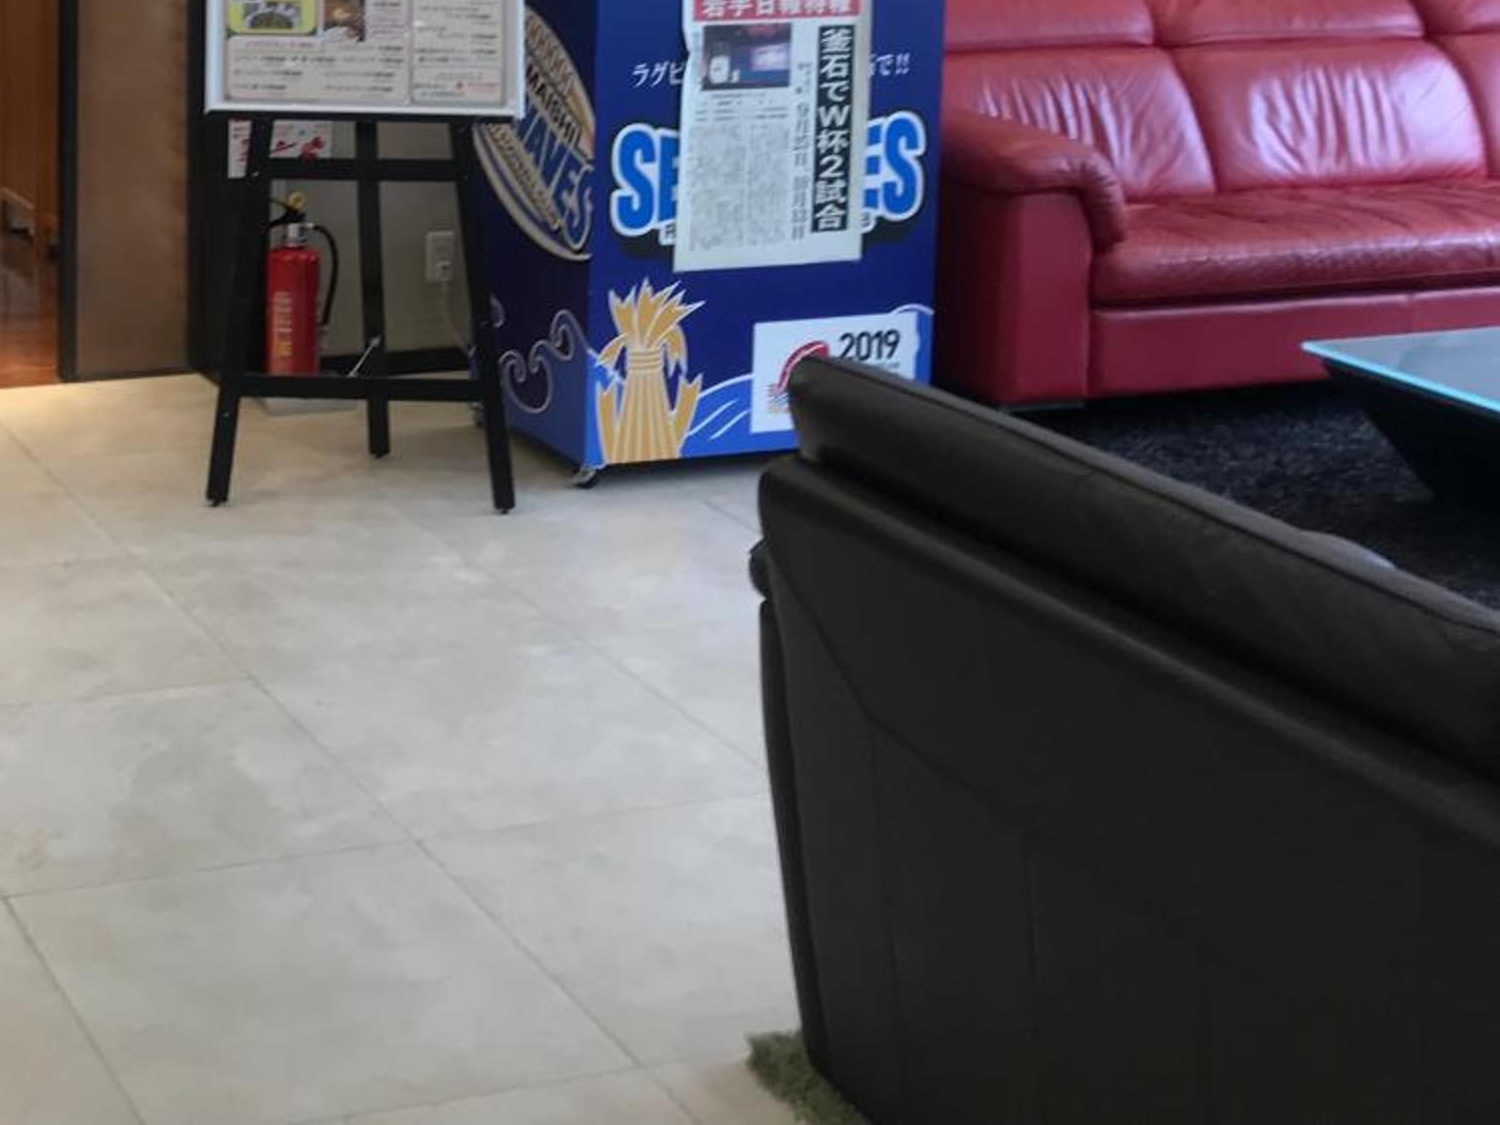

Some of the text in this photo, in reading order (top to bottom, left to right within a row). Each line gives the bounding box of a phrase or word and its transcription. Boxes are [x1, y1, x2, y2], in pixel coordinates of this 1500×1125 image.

[815, 27, 853, 231] 釜石でW杯2試合
[838, 328, 901, 362] 2019
